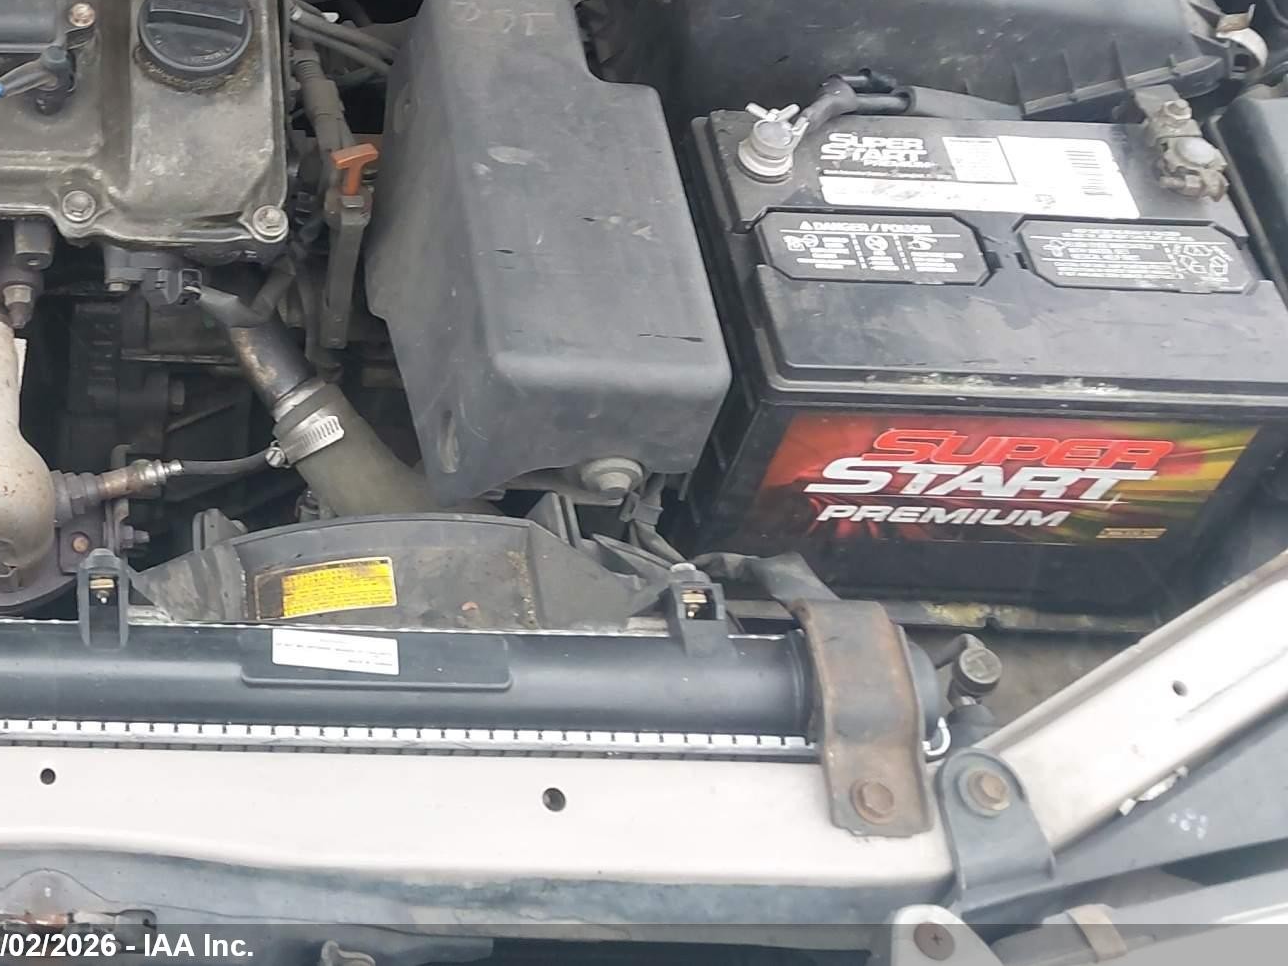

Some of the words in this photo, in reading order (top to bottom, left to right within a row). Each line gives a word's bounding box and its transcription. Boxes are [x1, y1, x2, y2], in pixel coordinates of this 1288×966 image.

[819, 142, 928, 162] START
[828, 132, 924, 151] SUPER
[861, 427, 1175, 470] SUPER
[803, 456, 1158, 501] START
[817, 504, 1071, 528] PREMIUM
